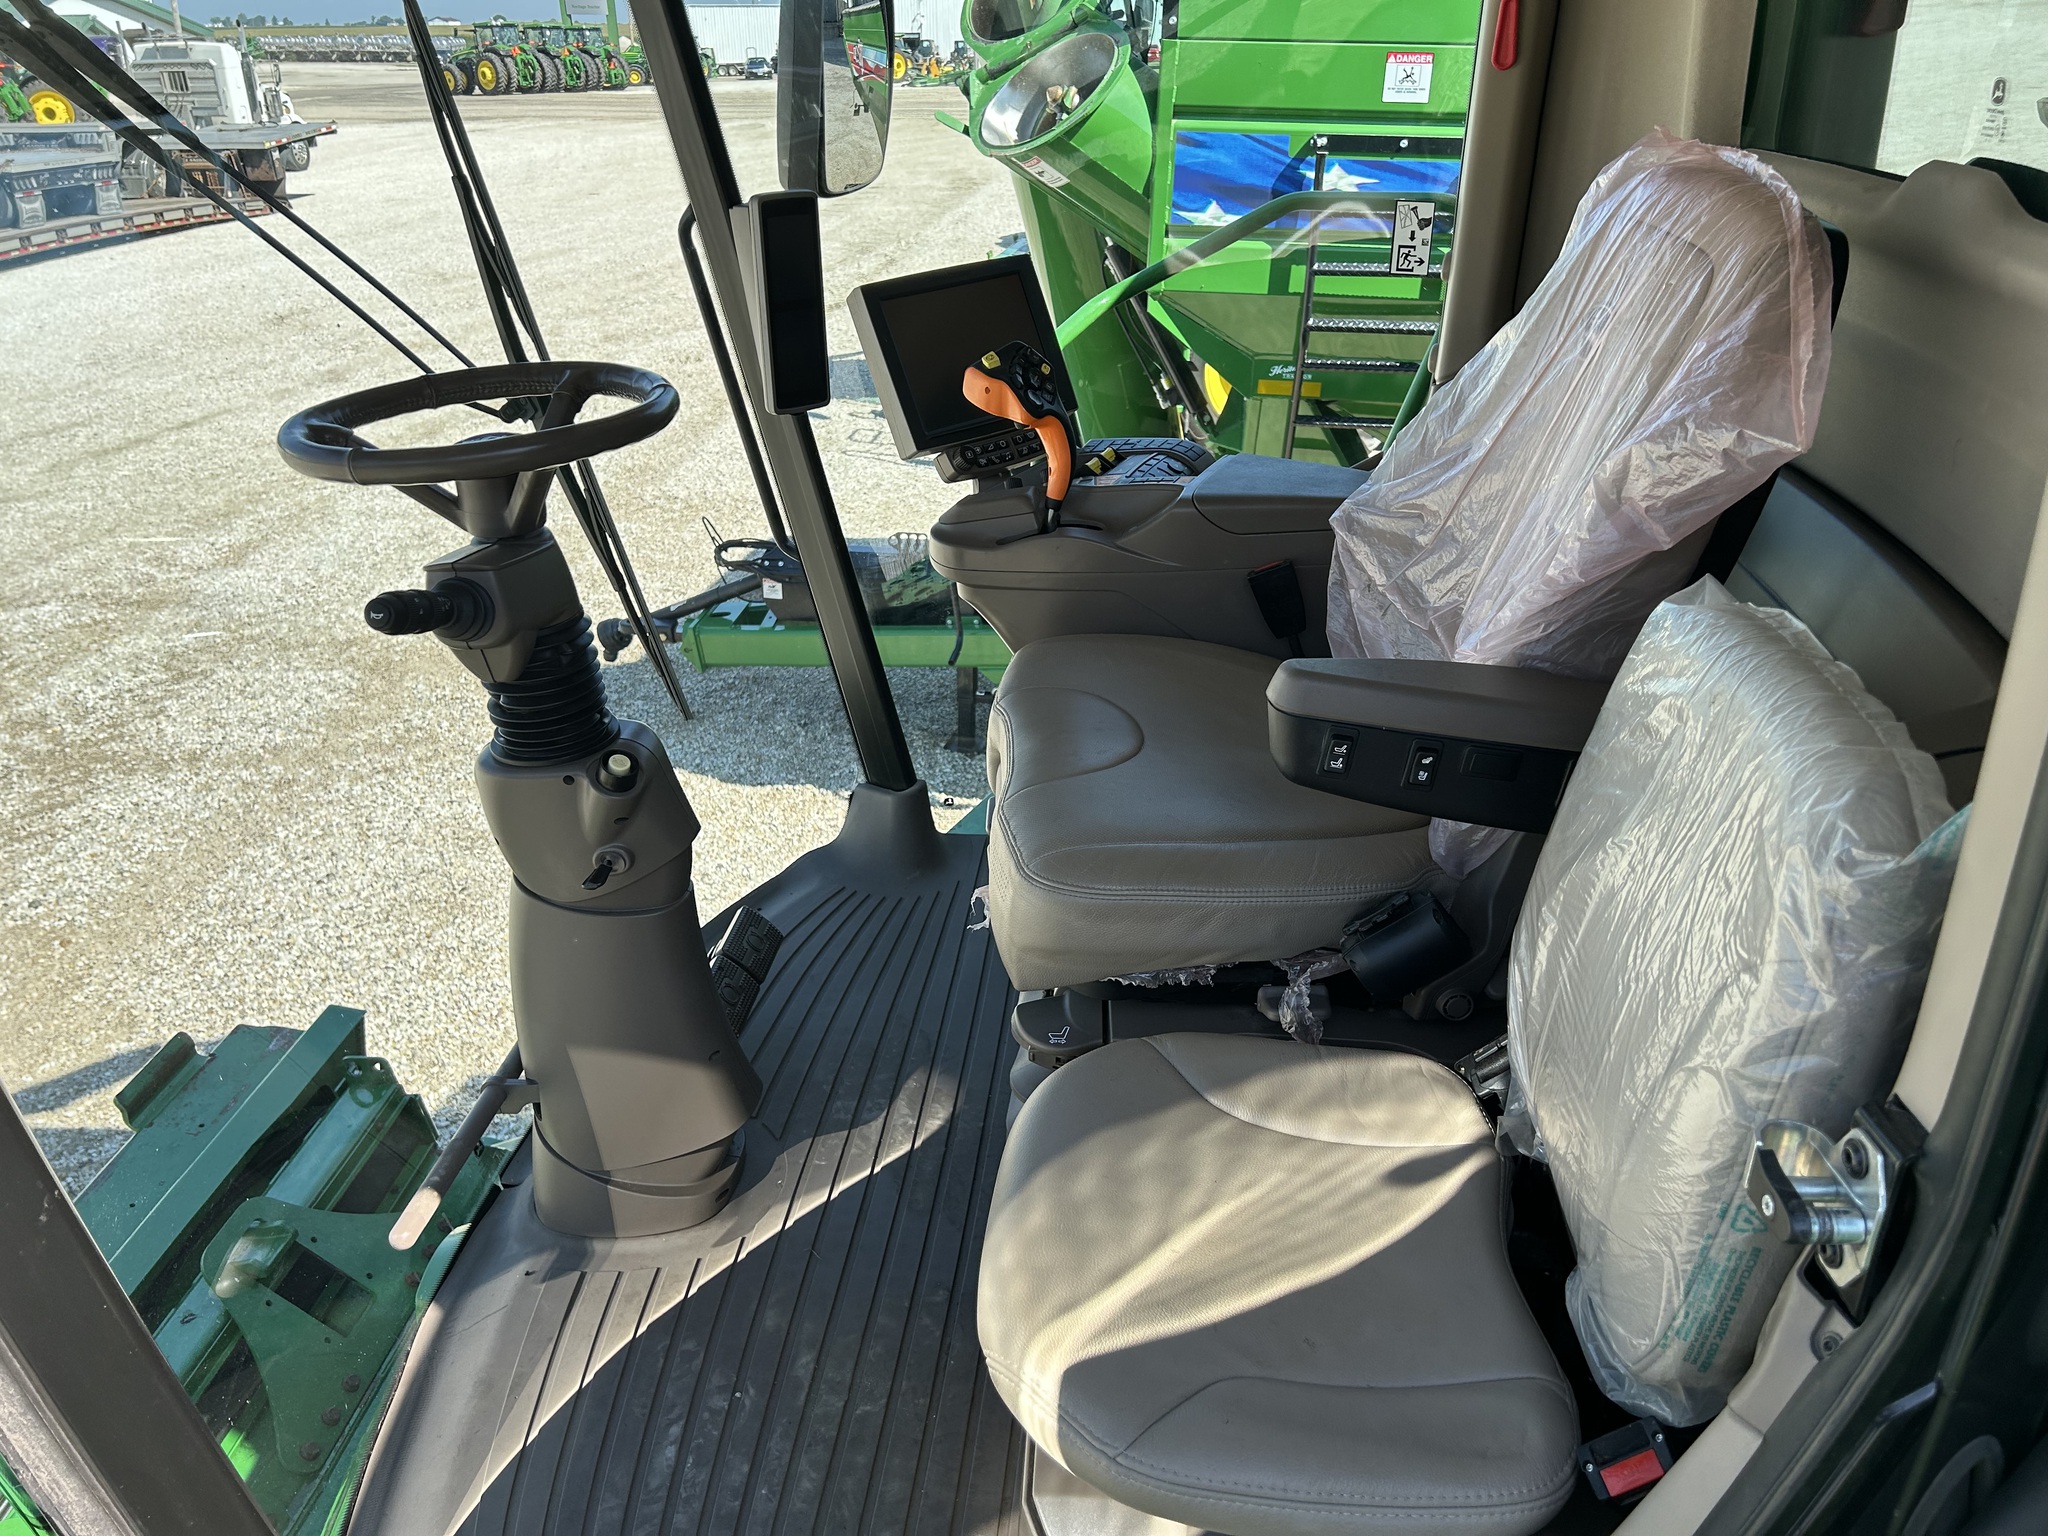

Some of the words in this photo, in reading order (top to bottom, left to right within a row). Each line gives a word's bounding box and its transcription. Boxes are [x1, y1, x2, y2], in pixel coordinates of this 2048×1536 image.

[1396, 54, 1433, 63] DANGER
[1729, 1247, 1762, 1303] RECYCLABLE
[1712, 1305, 1737, 1342] PLASTIC
